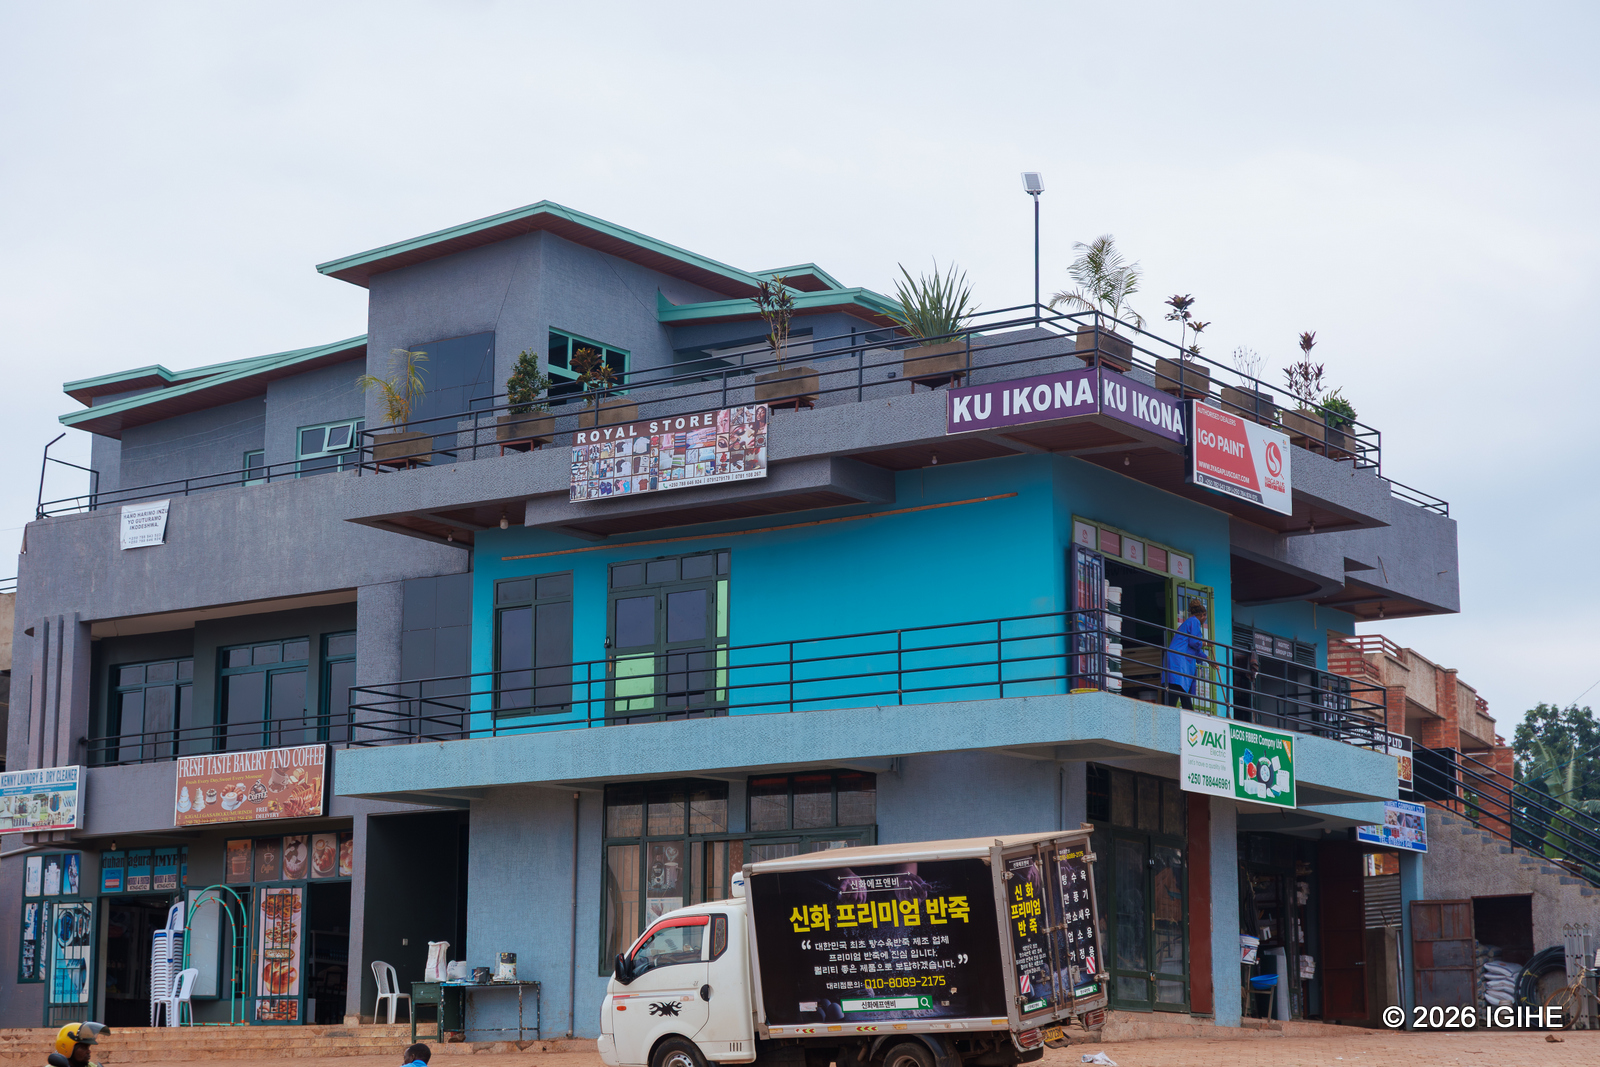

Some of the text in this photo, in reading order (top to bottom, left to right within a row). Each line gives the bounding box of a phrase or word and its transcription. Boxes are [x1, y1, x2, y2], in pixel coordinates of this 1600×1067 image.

[953, 378, 1094, 423] KU IKONA
[1104, 379, 1184, 435] KU IKONA
[1198, 406, 1236, 426] AUTHORISED DEALERS
[577, 414, 712, 444] ROYAL STORE
[1198, 428, 1244, 458] IGO PAINT
[1231, 728, 1245, 741] LAGOS
[1392, 738, 1402, 748] LTD
[1210, 748, 1226, 758] Electric
[179, 746, 324, 778] FRESH TASTE BAKERY AND COFFEE
[18, 772, 39, 785] LAUNDRY
[46, 770, 56, 782] DRY
[56, 769, 77, 781] CLEANER
[1188, 773, 1201, 785] +250
[850, 876, 900, 890] 신화에프앤비
[790, 895, 970, 933] 신화 프리미엄 반죽
[1011, 898, 1041, 919] 프리미엄
[814, 942, 847, 951] 대한민국
[850, 941, 866, 949] 최초
[913, 937, 930, 946] 제조
[932, 935, 950, 945] 업체
[829, 949, 938, 962] 프리미엄 반죽에 진심 입니다.
[841, 965, 857, 975] 좋은
[860, 963, 893, 973] 제품으로
[864, 976, 946, 989] 010-8089-2175
[861, 1000, 896, 1009] 신화에프앤비
